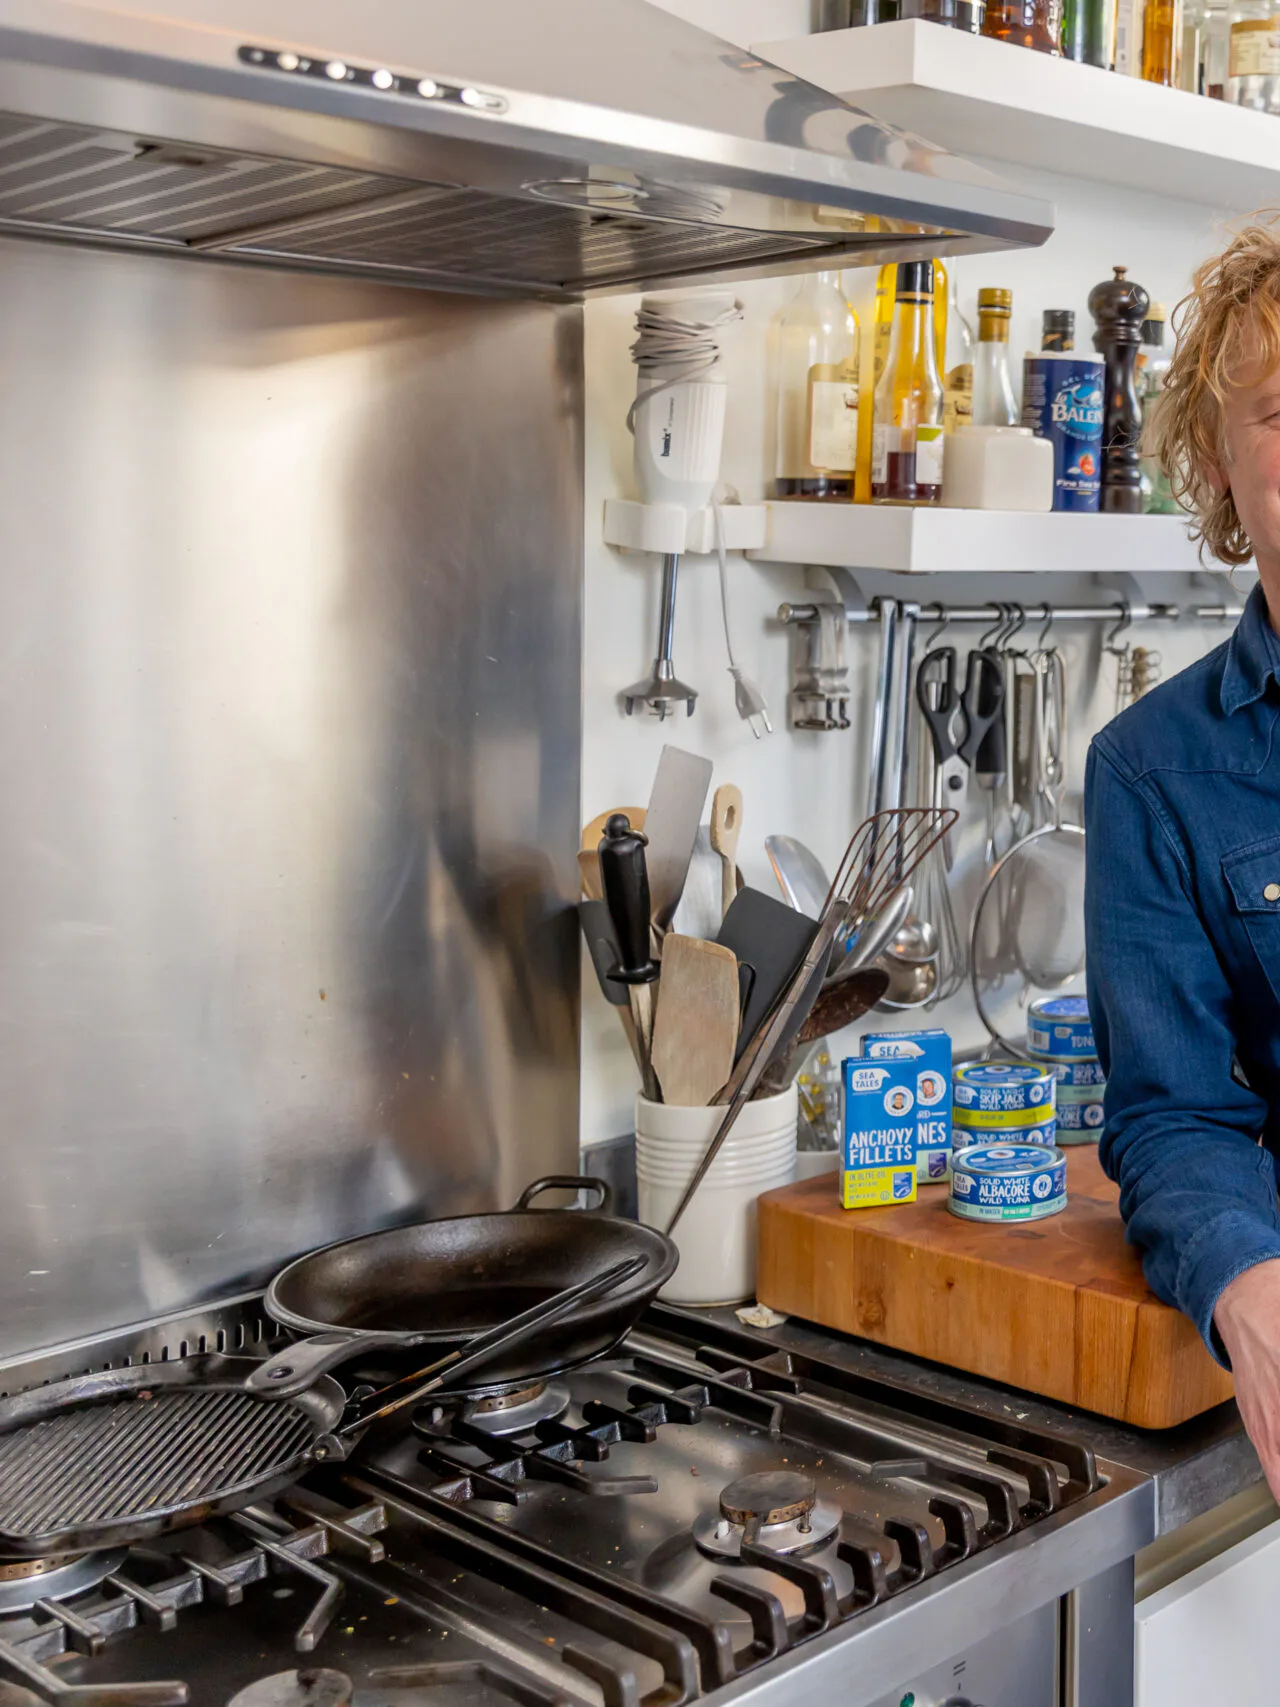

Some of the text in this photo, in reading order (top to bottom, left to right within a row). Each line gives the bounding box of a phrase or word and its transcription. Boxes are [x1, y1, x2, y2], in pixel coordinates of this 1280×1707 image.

[879, 1045, 901, 1057] SEA
[858, 1071, 875, 1080] SEA
[855, 1079, 880, 1089] TALES
[849, 1127, 914, 1149] ANCHOVY
[849, 1144, 913, 1166] FILLETS
[979, 1176, 1030, 1186] SOLID WHITE
[979, 1183, 1030, 1198] ALBACORE
[979, 1195, 1031, 1205] WILD TUNA
